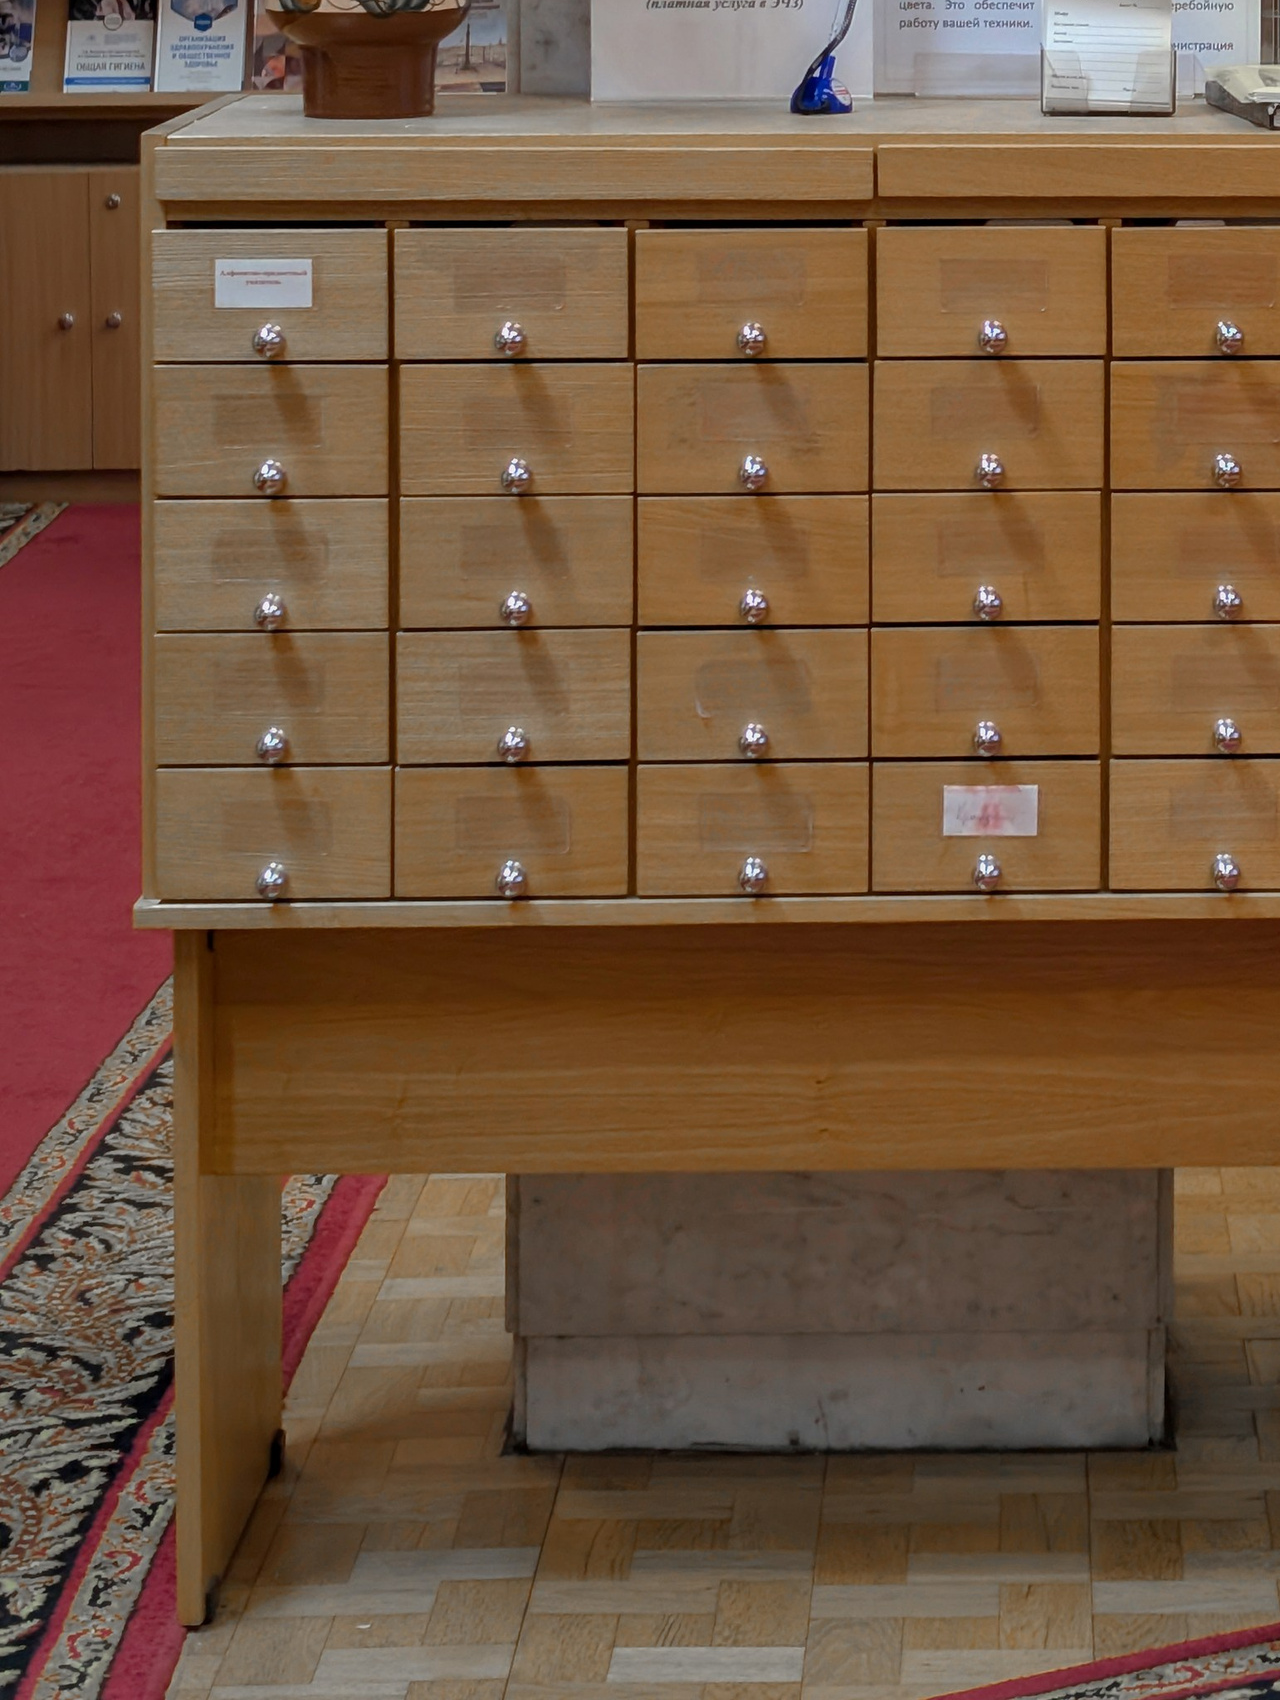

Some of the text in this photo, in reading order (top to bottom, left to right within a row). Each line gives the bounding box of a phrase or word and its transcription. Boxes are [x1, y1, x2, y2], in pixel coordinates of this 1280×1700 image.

[646, 0, 710, 9] (платная
[713, 0, 756, 11] услуга
[760, 0, 766, 8] в
[899, 2, 934, 11] цвета.
[945, 0, 965, 10] Это
[974, 0, 1034, 10] обеспечит
[899, 17, 1033, 30] работу вашей техники.
